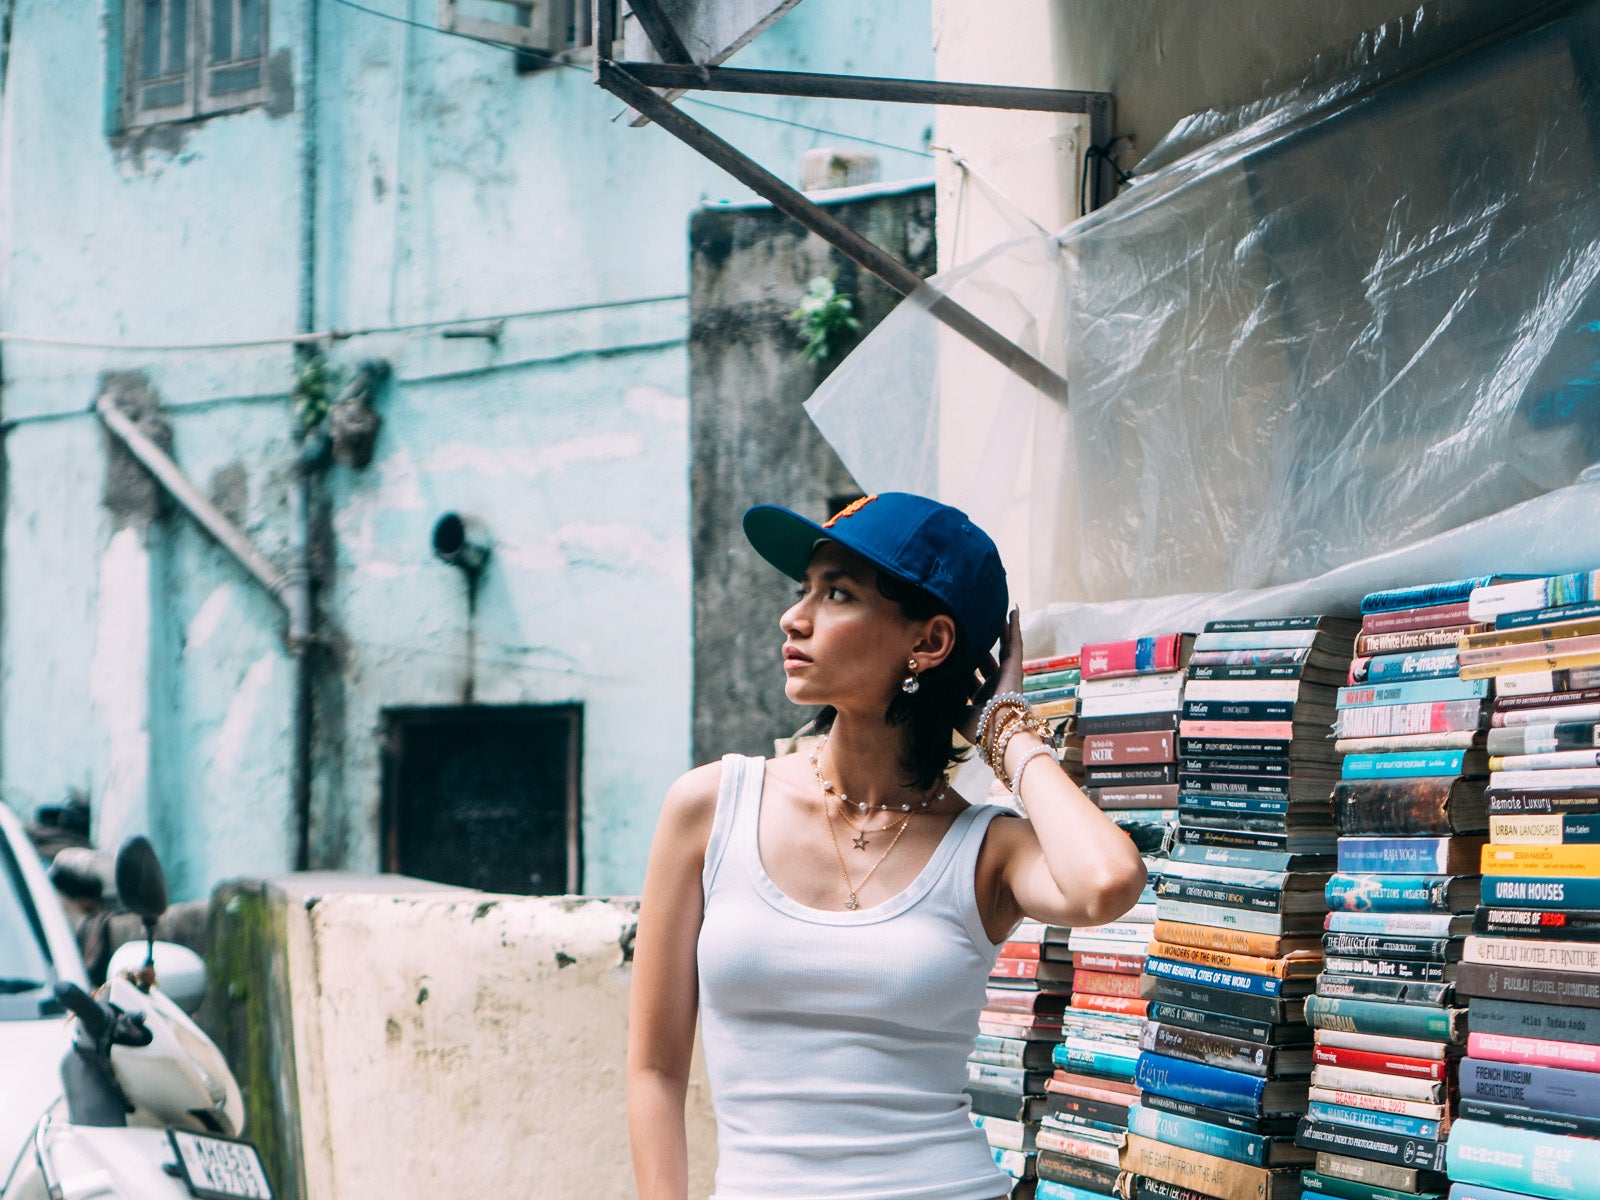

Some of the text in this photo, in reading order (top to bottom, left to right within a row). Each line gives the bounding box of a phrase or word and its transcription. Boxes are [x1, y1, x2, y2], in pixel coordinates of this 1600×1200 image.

[1367, 639, 1379, 650] The
[1379, 636, 1400, 649] White
[1401, 634, 1416, 648] Lions
[1417, 633, 1427, 646] of
[1491, 795, 1551, 811] Remote Luxury
[1496, 824, 1560, 836] URBAN LANDSCAPES
[1496, 882, 1564, 901] URBAN HOUSES
[1488, 910, 1530, 925] TOUCHSTONES
[1531, 912, 1541, 926] OF
[1164, 946, 1231, 966] WONDERS OF THE WORLD
[1157, 963, 1172, 973] MOST
[1171, 965, 1197, 979] BEAUTIFUL
[1197, 968, 1213, 982] CITIES
[1212, 971, 1221, 983] OF
[1221, 973, 1231, 985] THE
[1231, 976, 1251, 988] WORLD
[1363, 960, 1378, 976] Dog
[1378, 961, 1395, 974] Dirt
[1160, 1005, 1176, 1018] CAMPUS
[1181, 1009, 1206, 1024] COMMUNITY
[1313, 1013, 1358, 1032] AUSTRALIA
[1139, 1058, 1169, 1090] Egypt
[1475, 1066, 1532, 1085] FRENCH MUSEUM
[1476, 1082, 1526, 1101] ARCHITECTURE
[1335, 1092, 1407, 1114] BEANO ANNUAL 2003
[1140, 1149, 1224, 1184] THE EARTH FROM THE AIR
[1145, 1177, 1181, 1199] TAKE BETTER
